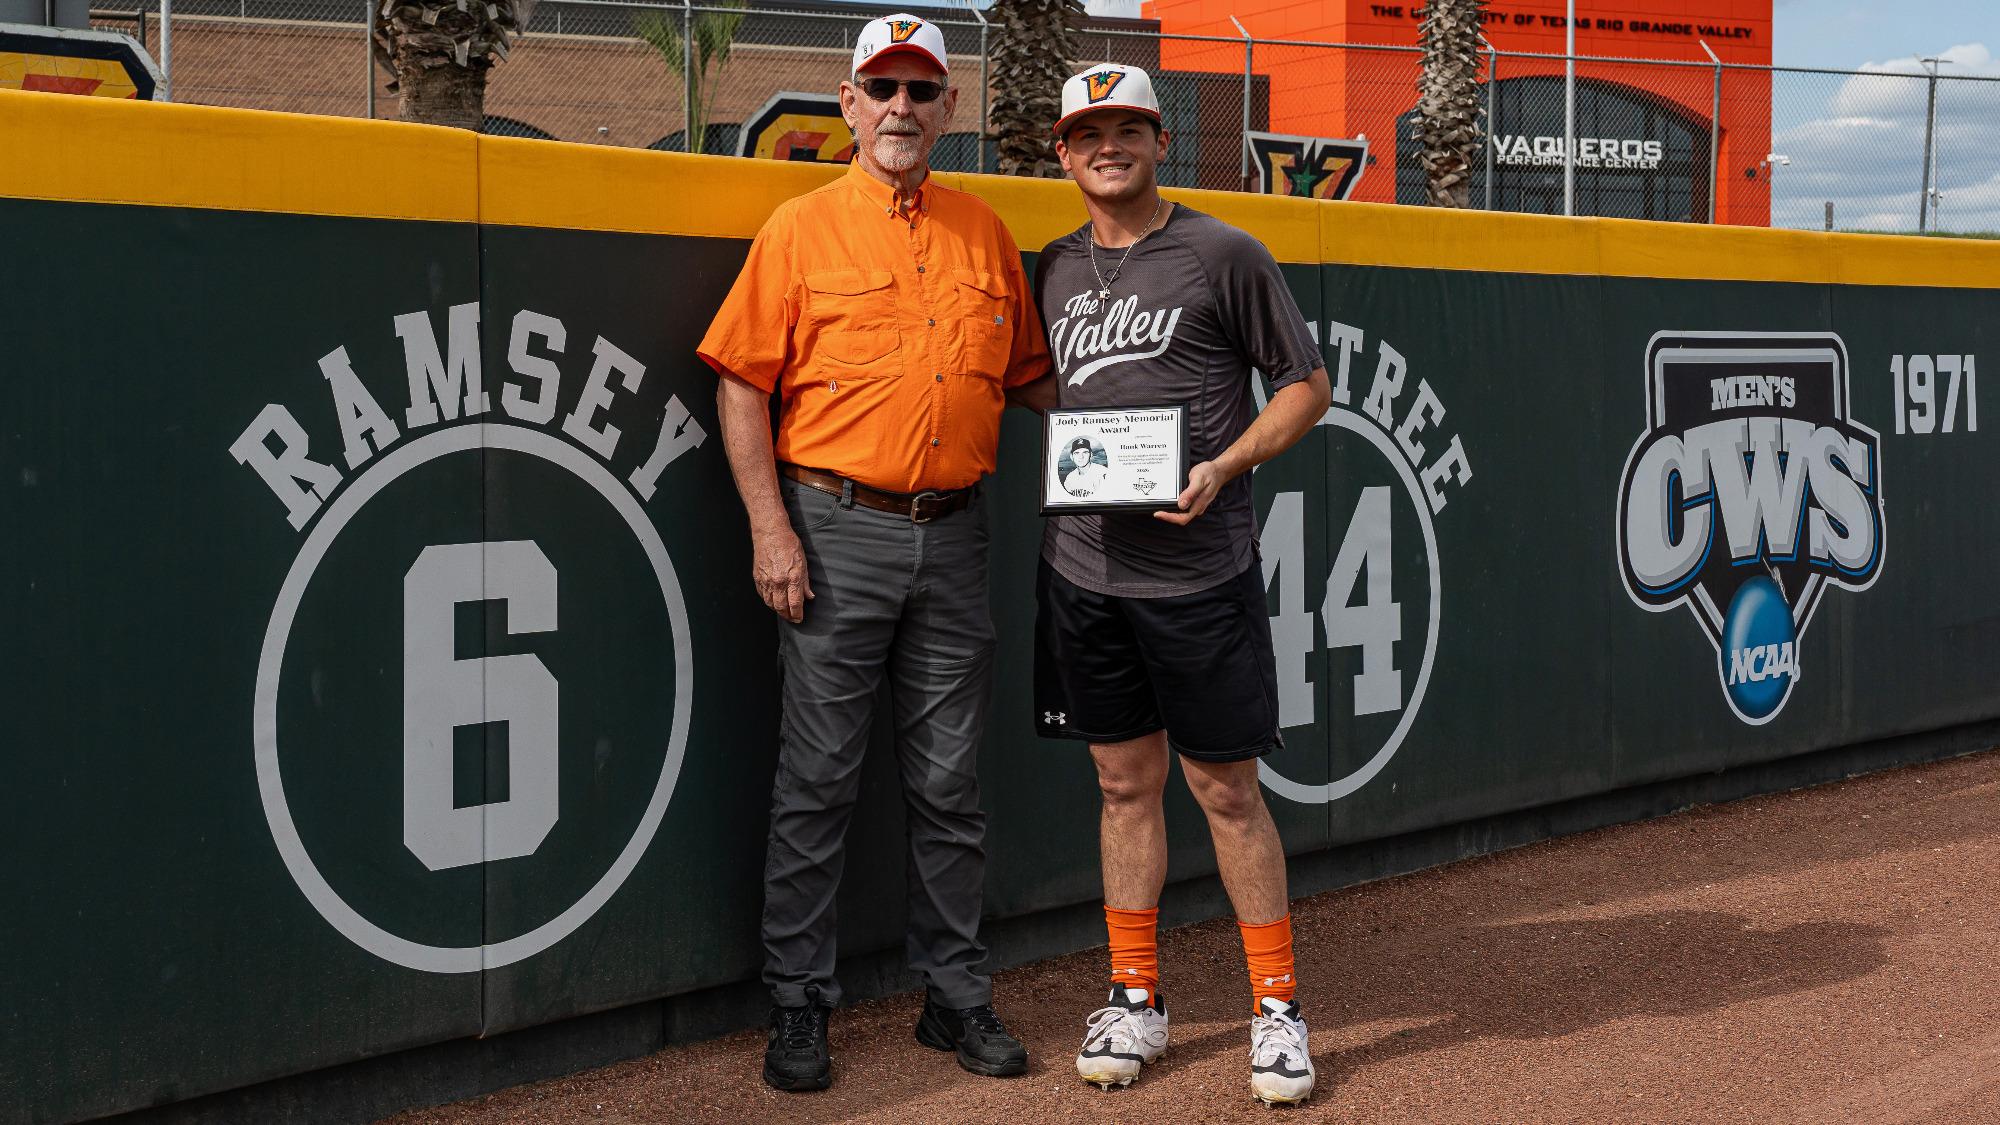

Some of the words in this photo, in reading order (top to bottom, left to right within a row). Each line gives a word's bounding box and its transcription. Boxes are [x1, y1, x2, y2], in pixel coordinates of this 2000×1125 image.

[1371, 5, 1403, 17] THE
[1513, 14, 1535, 25] OF
[1540, 15, 1590, 29] TEXAS
[1596, 19, 1623, 31] RIO
[1629, 21, 1692, 35] GRANDE
[1697, 25, 1752, 38] VALLEY
[1493, 134, 1662, 161] VAQUEROS
[1496, 154, 1600, 168] PERFORMNCE
[1605, 158, 1658, 170] CENTER
[1065, 290, 1099, 318] The
[1050, 295, 1182, 374] Valley
[1711, 375, 1796, 410] MEN'S
[1889, 354, 1977, 435] 1971
[228, 301, 708, 533] RAMSEY
[1056, 418, 1080, 426] Jody
[1082, 415, 1122, 424] Ramsey
[1124, 413, 1174, 423] Memorial
[1099, 426, 1130, 434] Award
[1627, 416, 1875, 588] CWS
[1729, 641, 1798, 685] NCAA
[403, 539, 559, 871] 6
